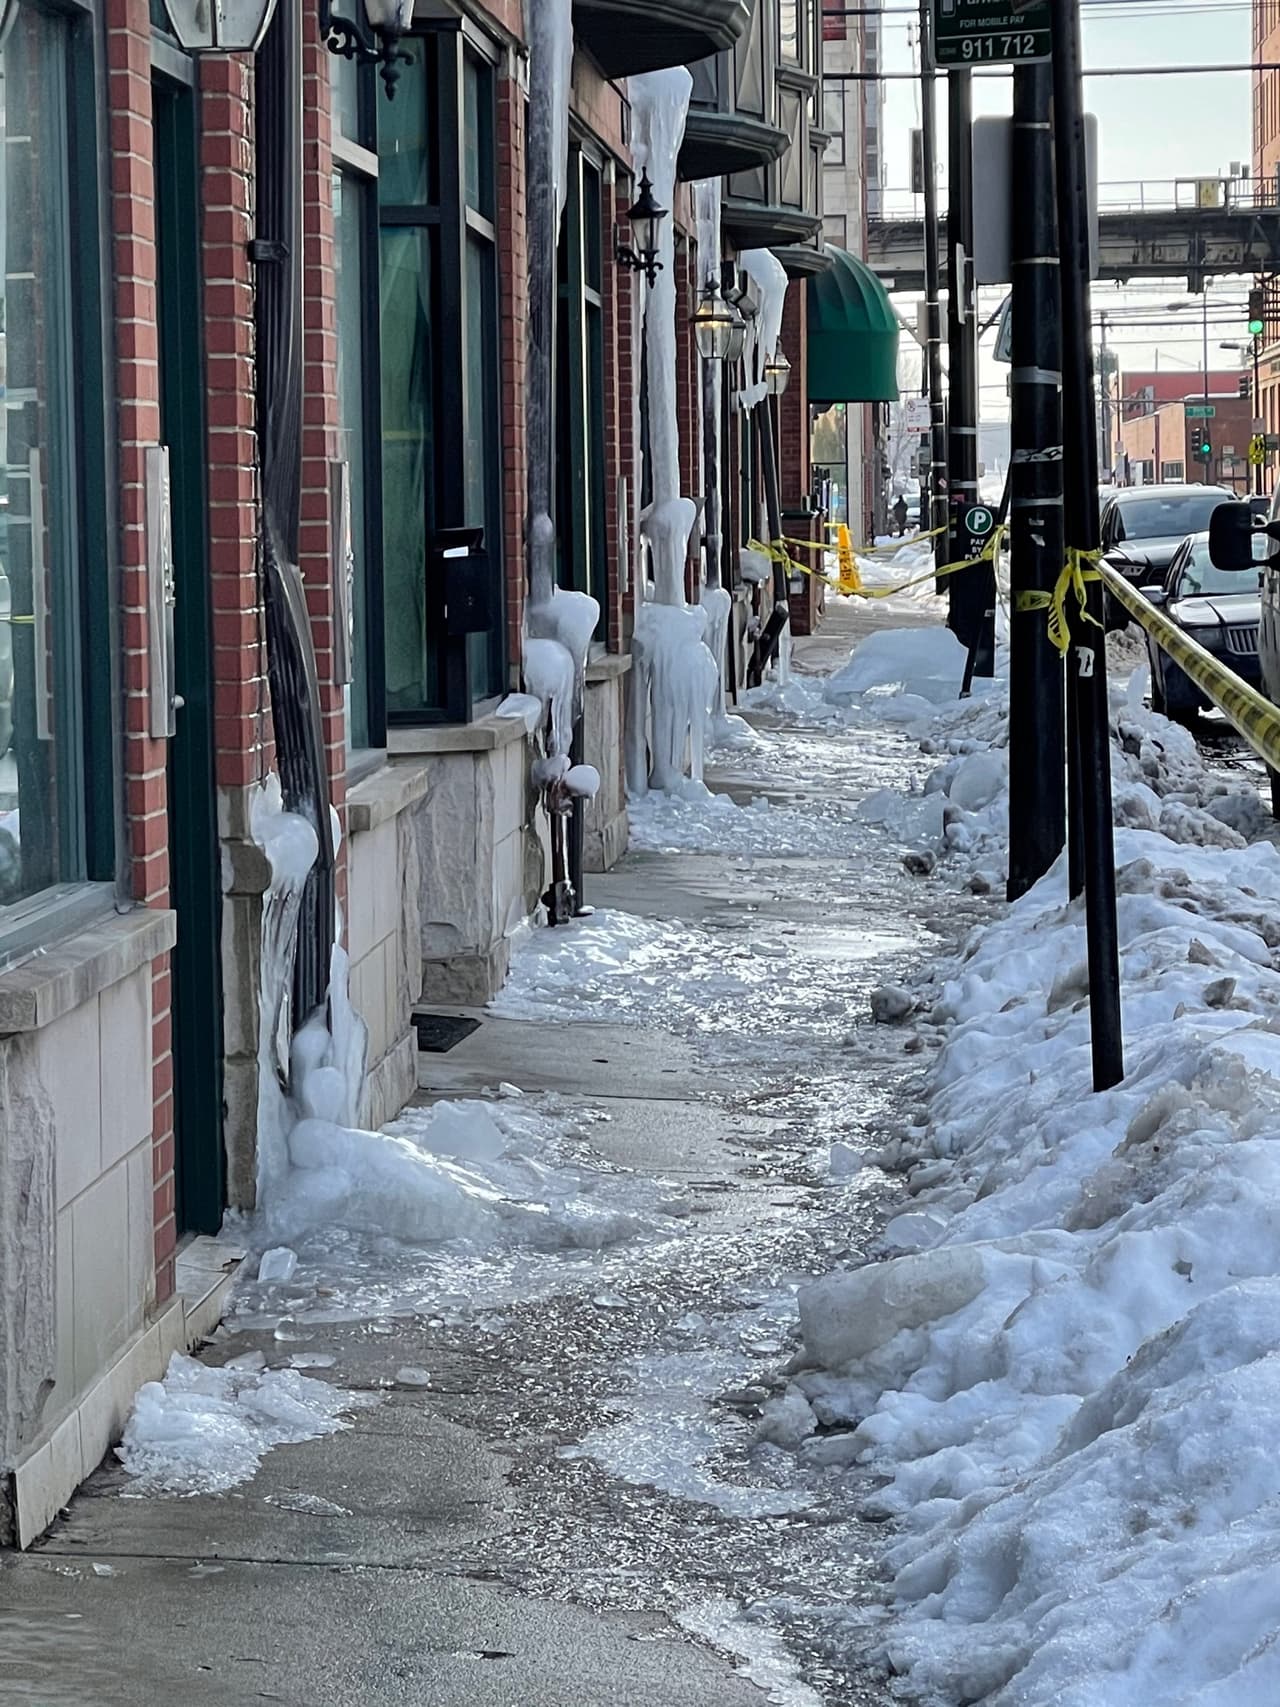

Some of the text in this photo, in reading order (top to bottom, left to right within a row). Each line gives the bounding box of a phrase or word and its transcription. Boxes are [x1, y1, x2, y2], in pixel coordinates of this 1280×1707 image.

[959, 15, 1024, 28] FOR MOBILE PAY
[962, 38, 993, 59] 911
[1000, 34, 1034, 56] 712
[974, 511, 986, 530] P
